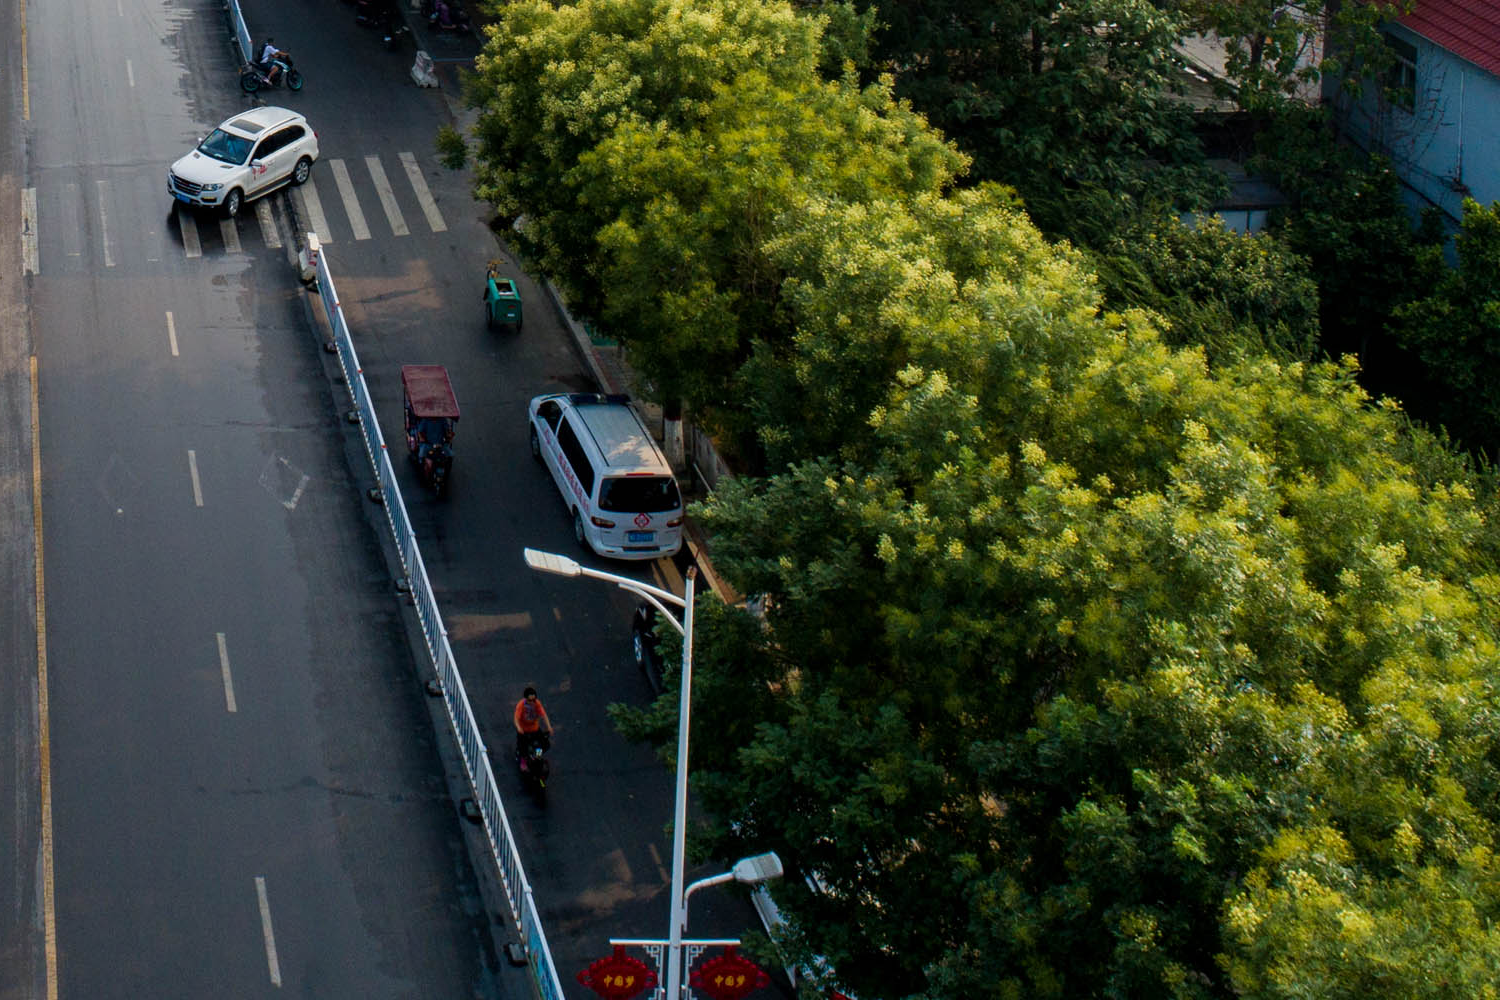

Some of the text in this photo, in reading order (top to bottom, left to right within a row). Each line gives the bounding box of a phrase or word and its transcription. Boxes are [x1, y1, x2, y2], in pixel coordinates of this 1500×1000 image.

[603, 975, 635, 987] 中国梦
[714, 975, 746, 987] 中国梦
